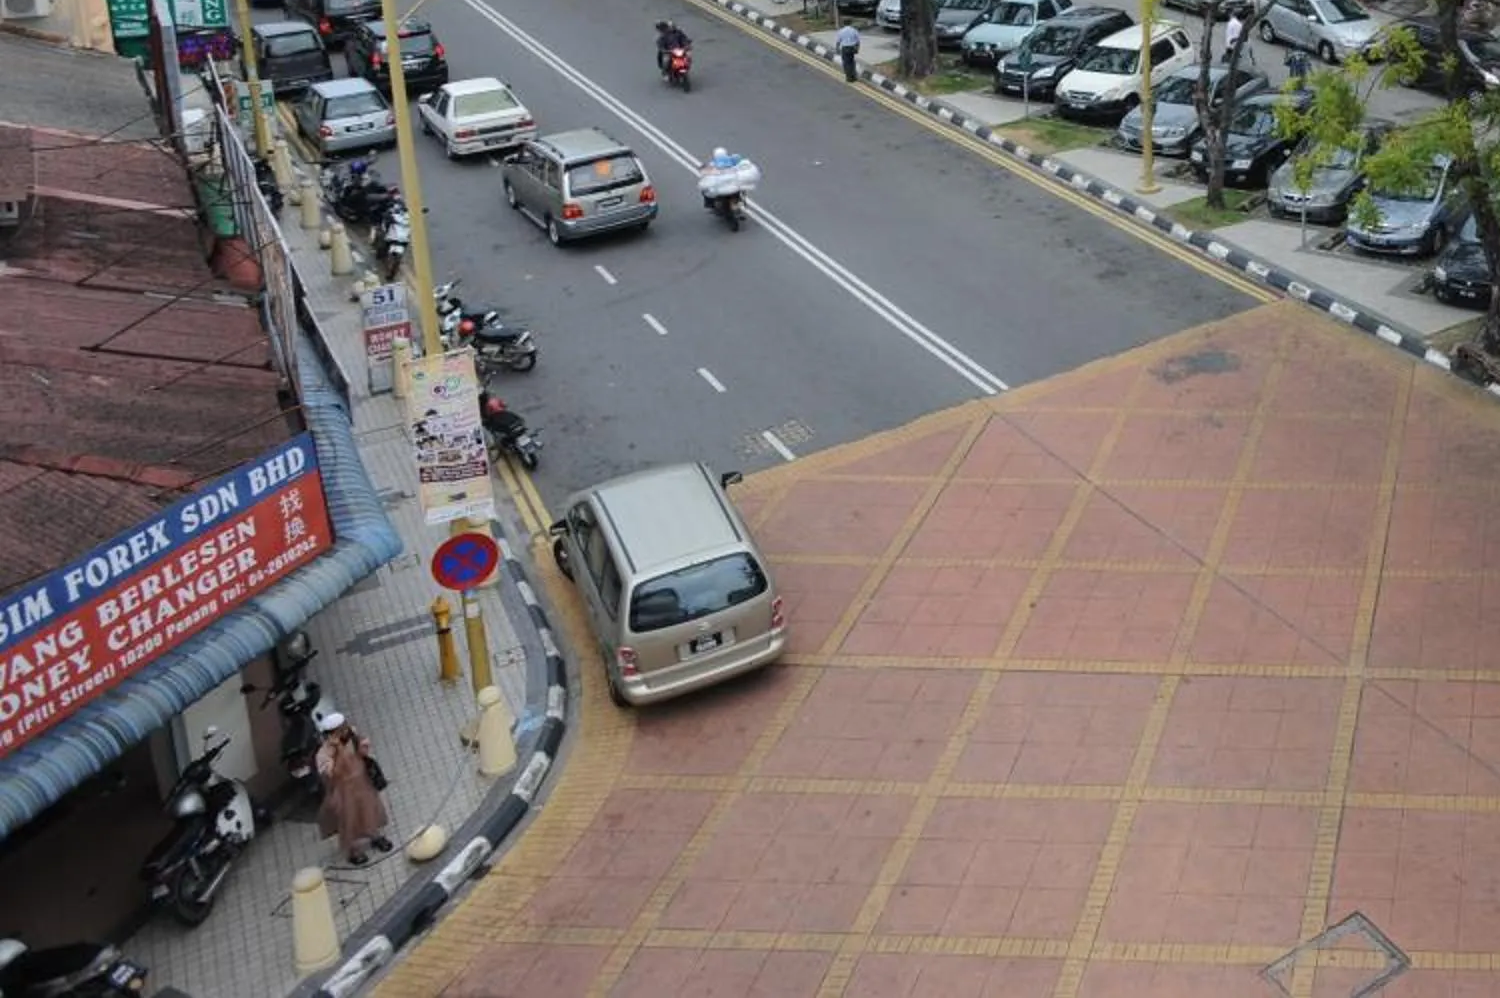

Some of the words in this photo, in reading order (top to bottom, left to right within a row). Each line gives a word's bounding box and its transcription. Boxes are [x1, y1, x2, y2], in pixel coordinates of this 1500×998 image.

[373, 288, 395, 305] 51
[63, 519, 171, 602] FOREX
[180, 481, 239, 534] SDN
[247, 447, 305, 496] BHD
[96, 516, 257, 627] BERLESEN
[107, 548, 257, 651] CHANGER
[119, 633, 163, 670] 10200
[165, 599, 218, 640] Penang
